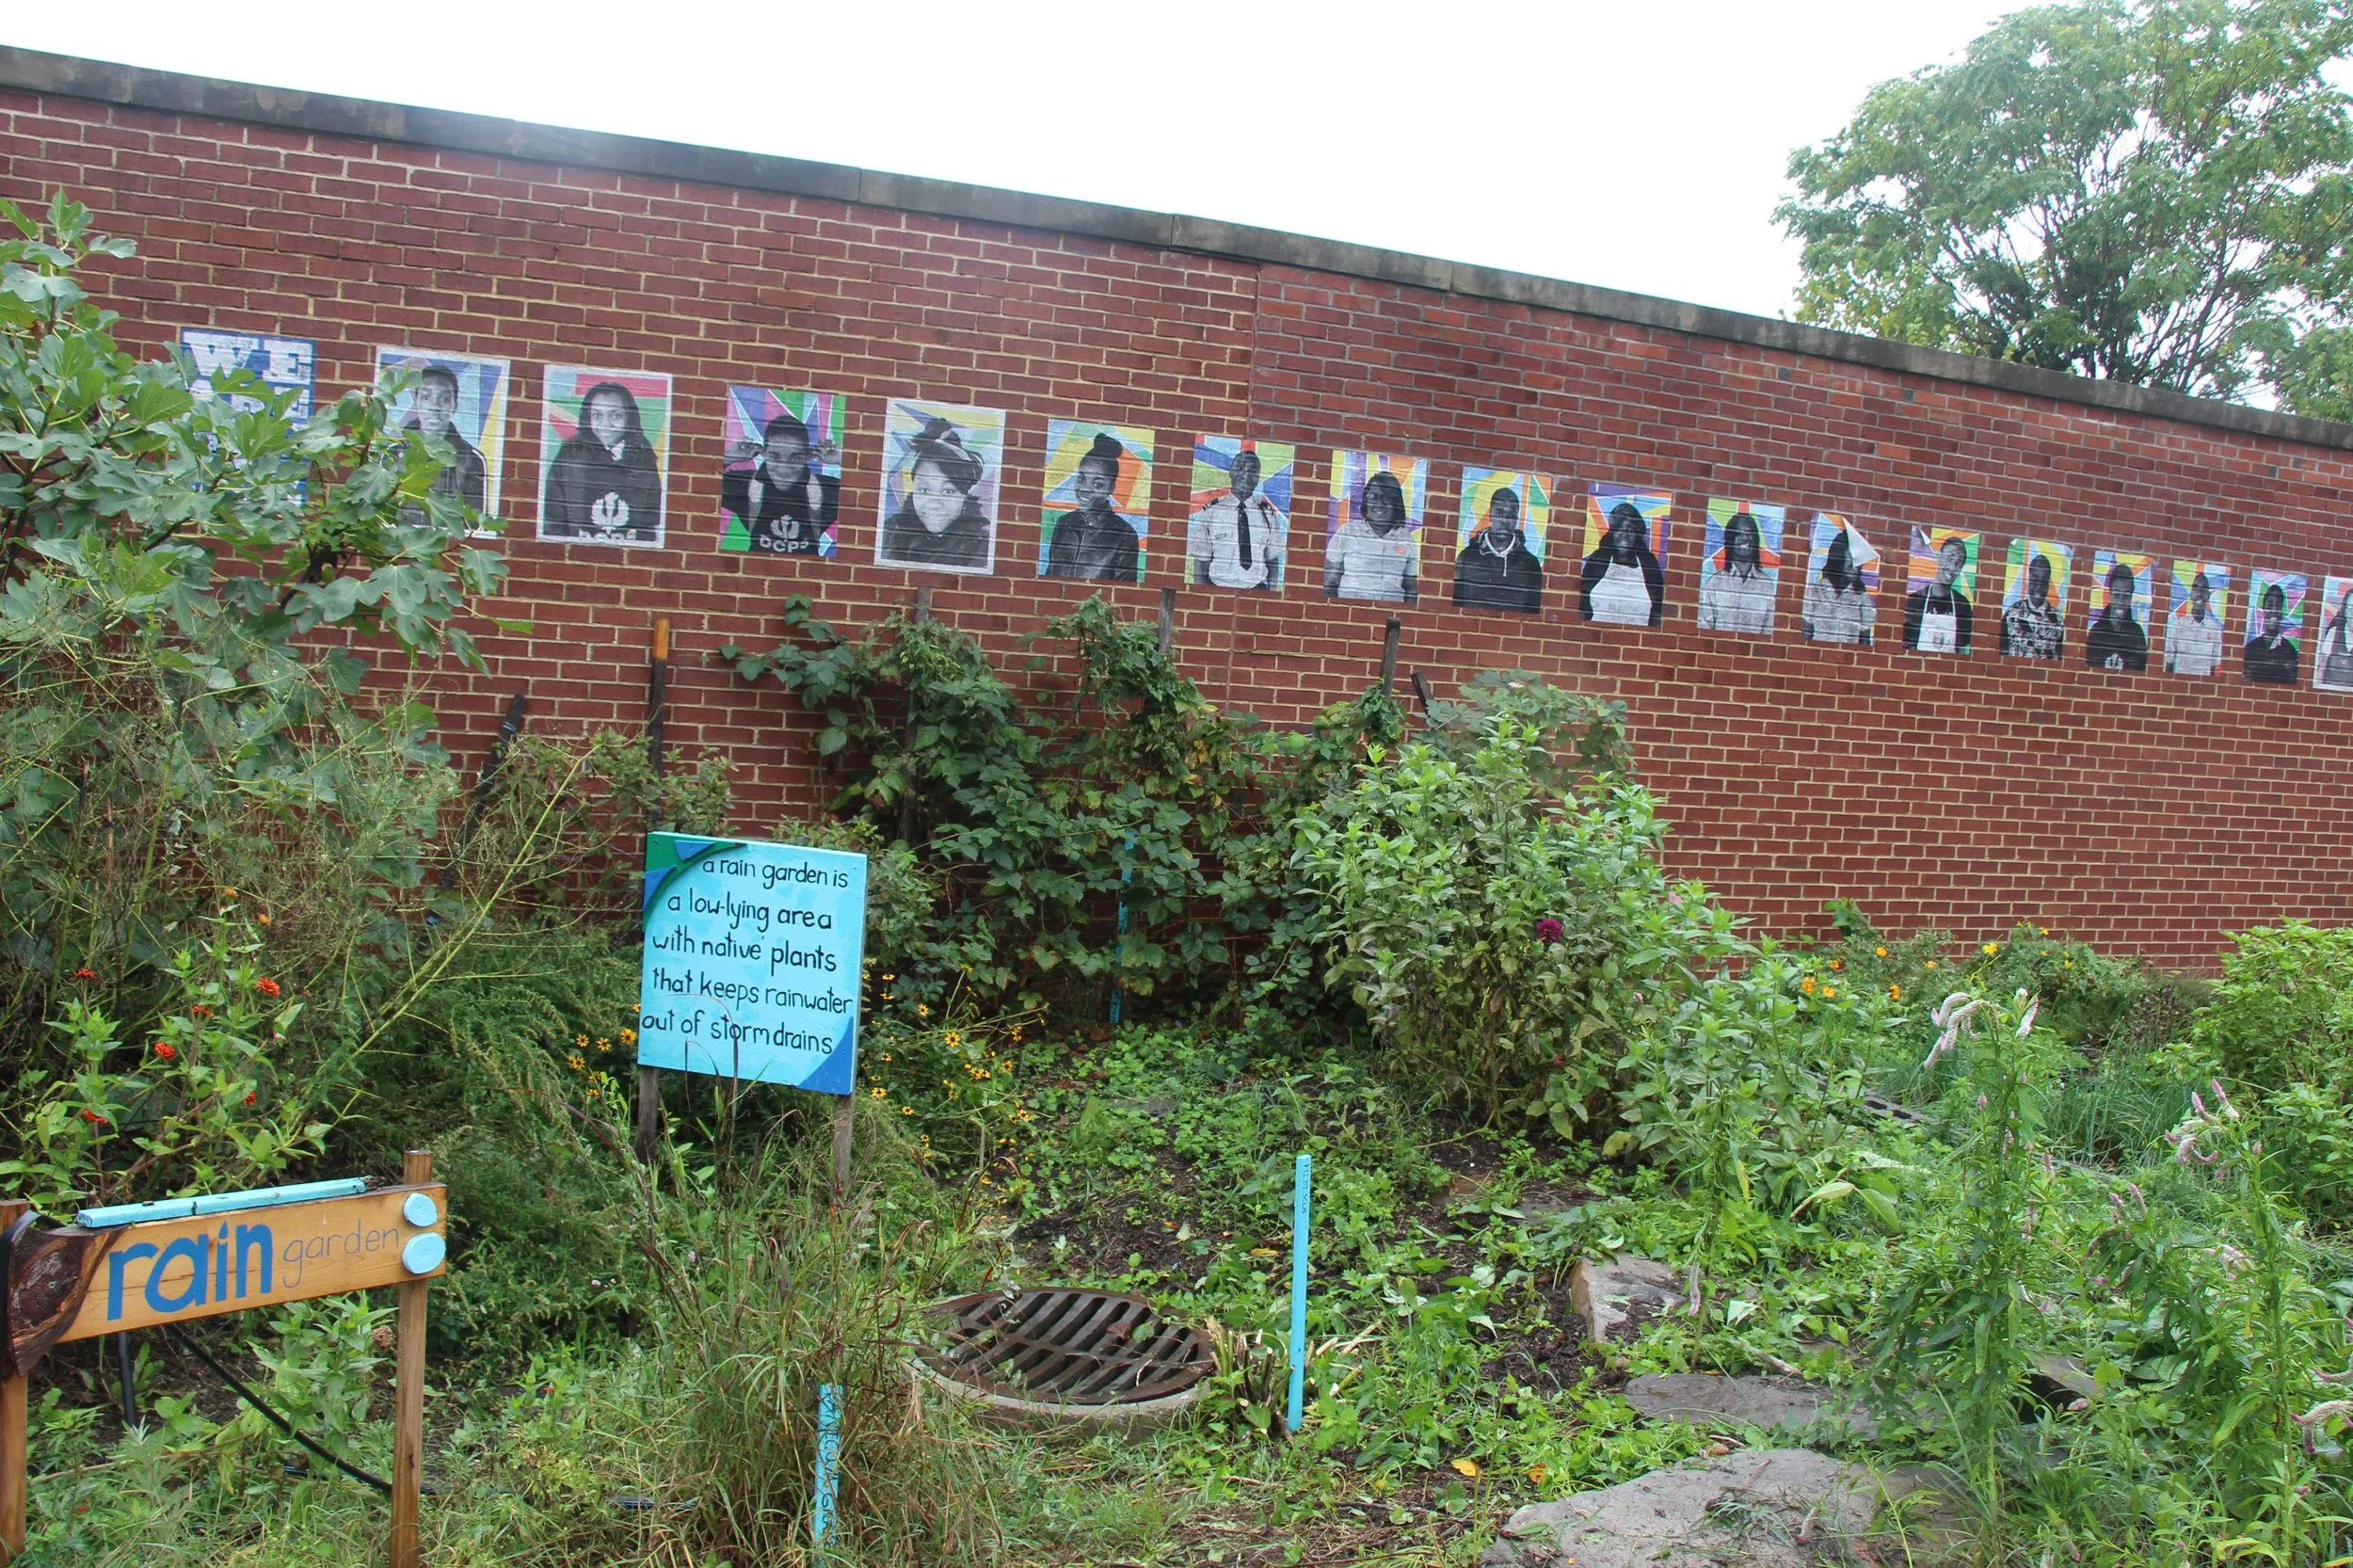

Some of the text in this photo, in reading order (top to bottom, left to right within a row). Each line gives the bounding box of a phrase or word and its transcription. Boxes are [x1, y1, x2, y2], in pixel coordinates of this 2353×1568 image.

[183, 331, 313, 385] WE
[702, 859, 849, 889] a rain garden is
[667, 887, 832, 933] a low-lying area
[652, 924, 837, 977] with native plants
[652, 968, 853, 1015] that keeps rainwater
[642, 1009, 675, 1032] out
[680, 1009, 706, 1036] of
[107, 1220, 400, 1320] rain garden
